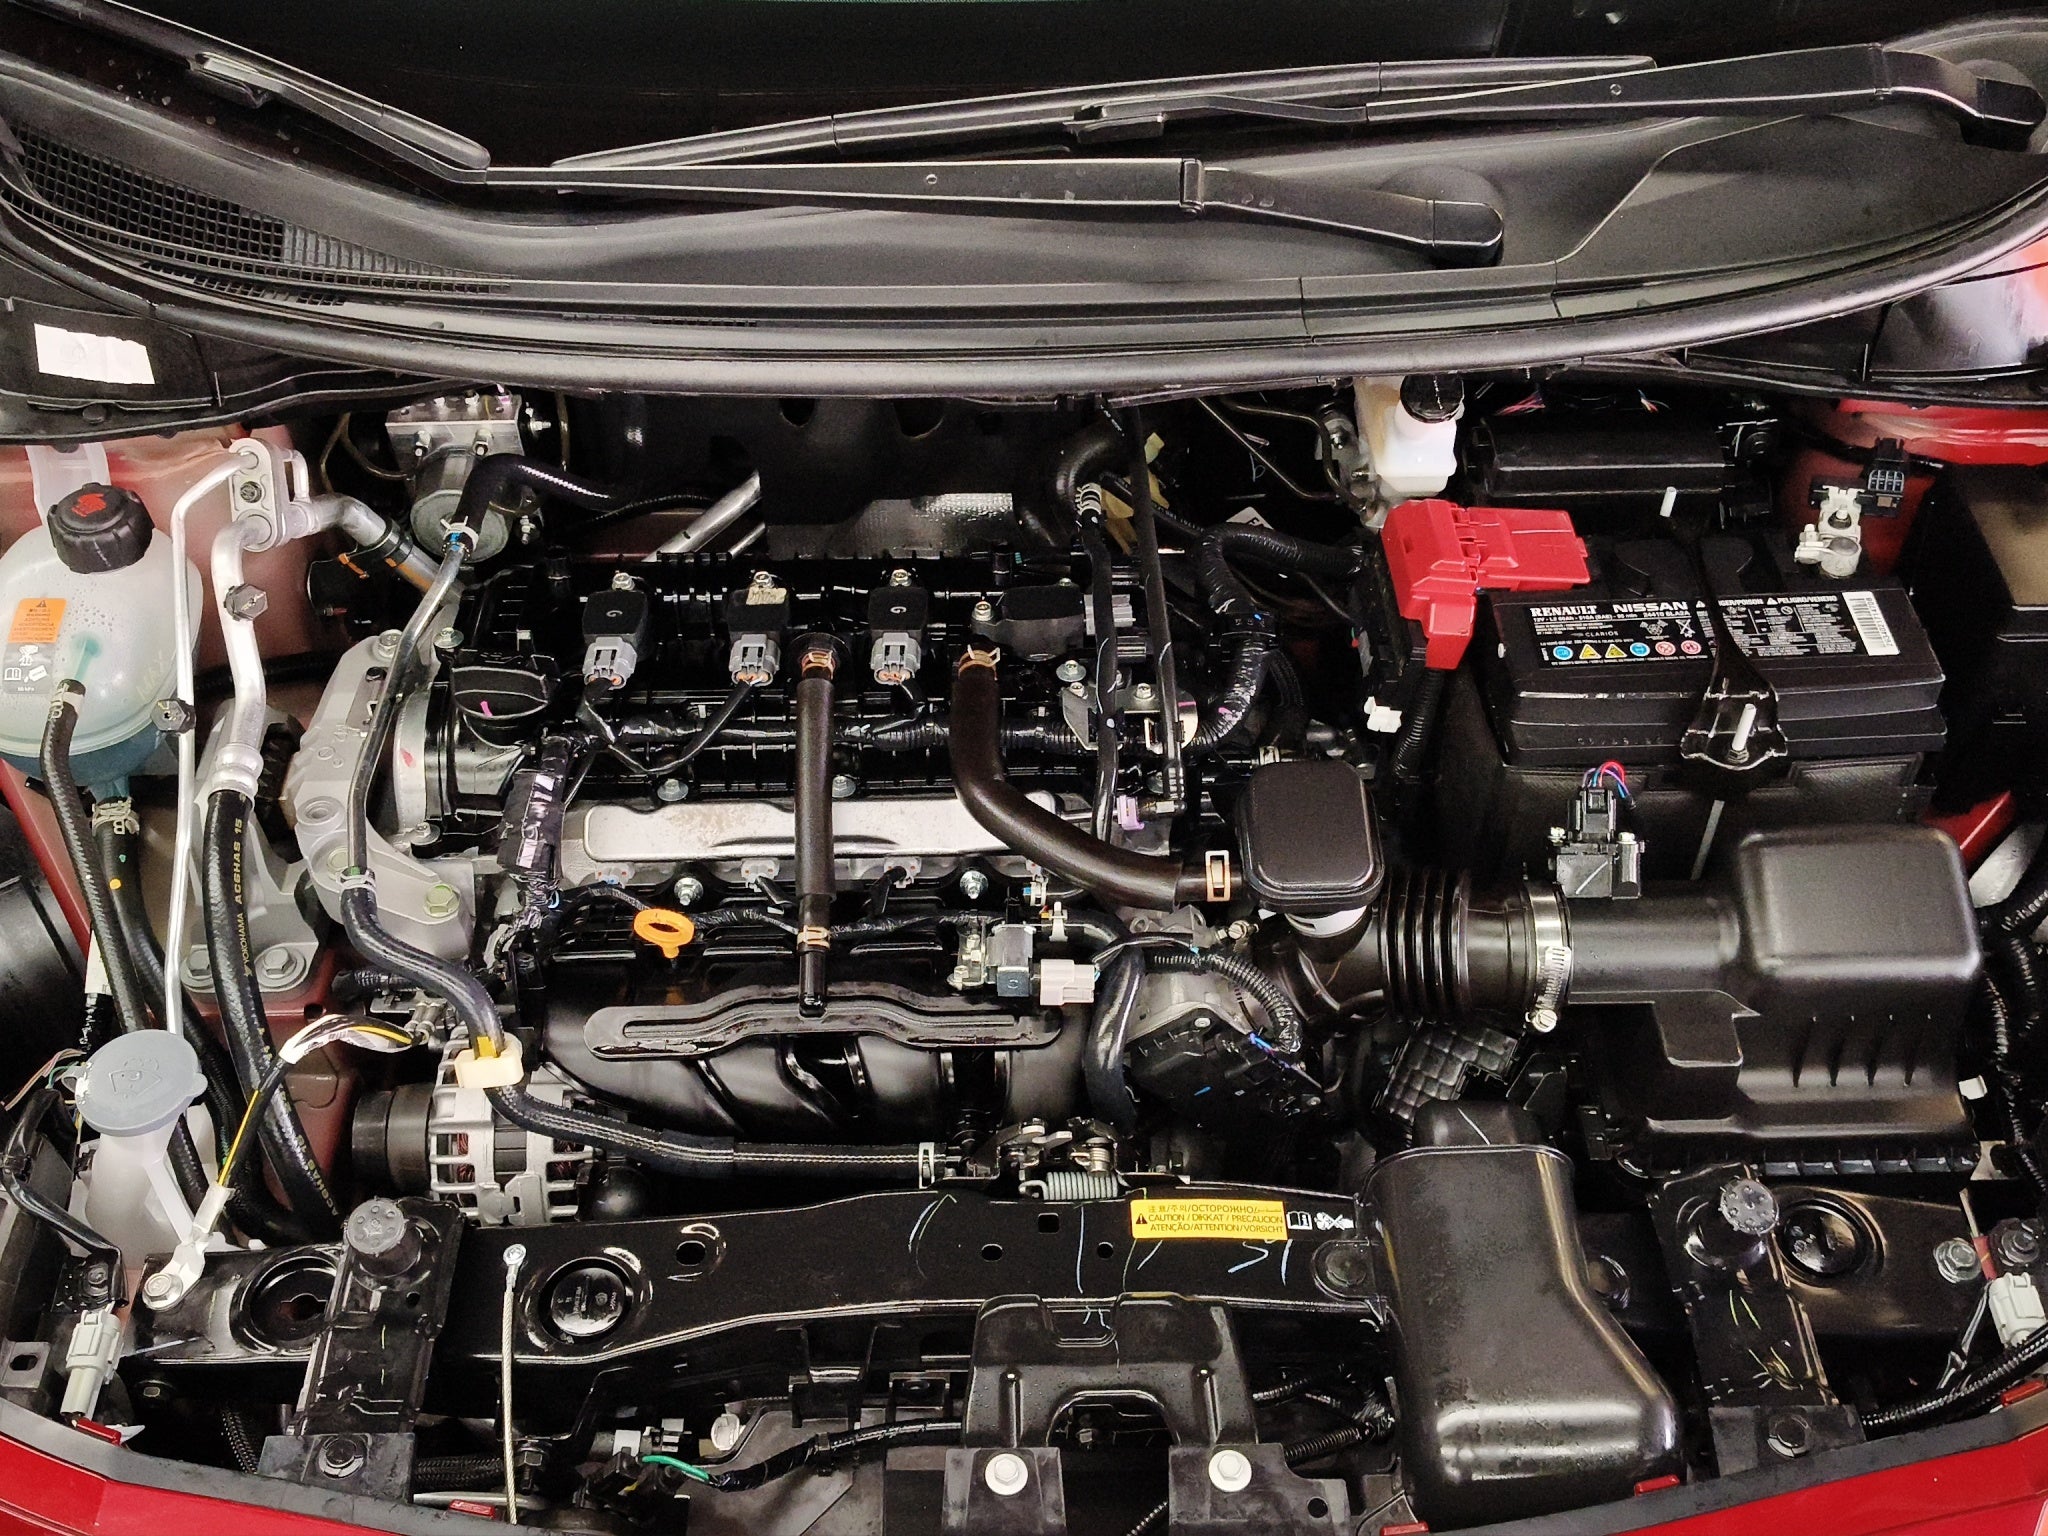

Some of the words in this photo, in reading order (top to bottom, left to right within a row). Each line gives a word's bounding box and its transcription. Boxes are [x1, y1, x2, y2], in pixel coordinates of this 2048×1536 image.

[1529, 605, 1597, 617] RENAULT
[1612, 601, 1689, 613] NISSAN
[234, 818, 243, 834] 15
[236, 912, 249, 966] YOKOHAMA
[1149, 1214, 1185, 1222] CAUTION
[1192, 1214, 1224, 1222] DIKKAT
[1232, 1215, 1283, 1224] PRECAUCION
